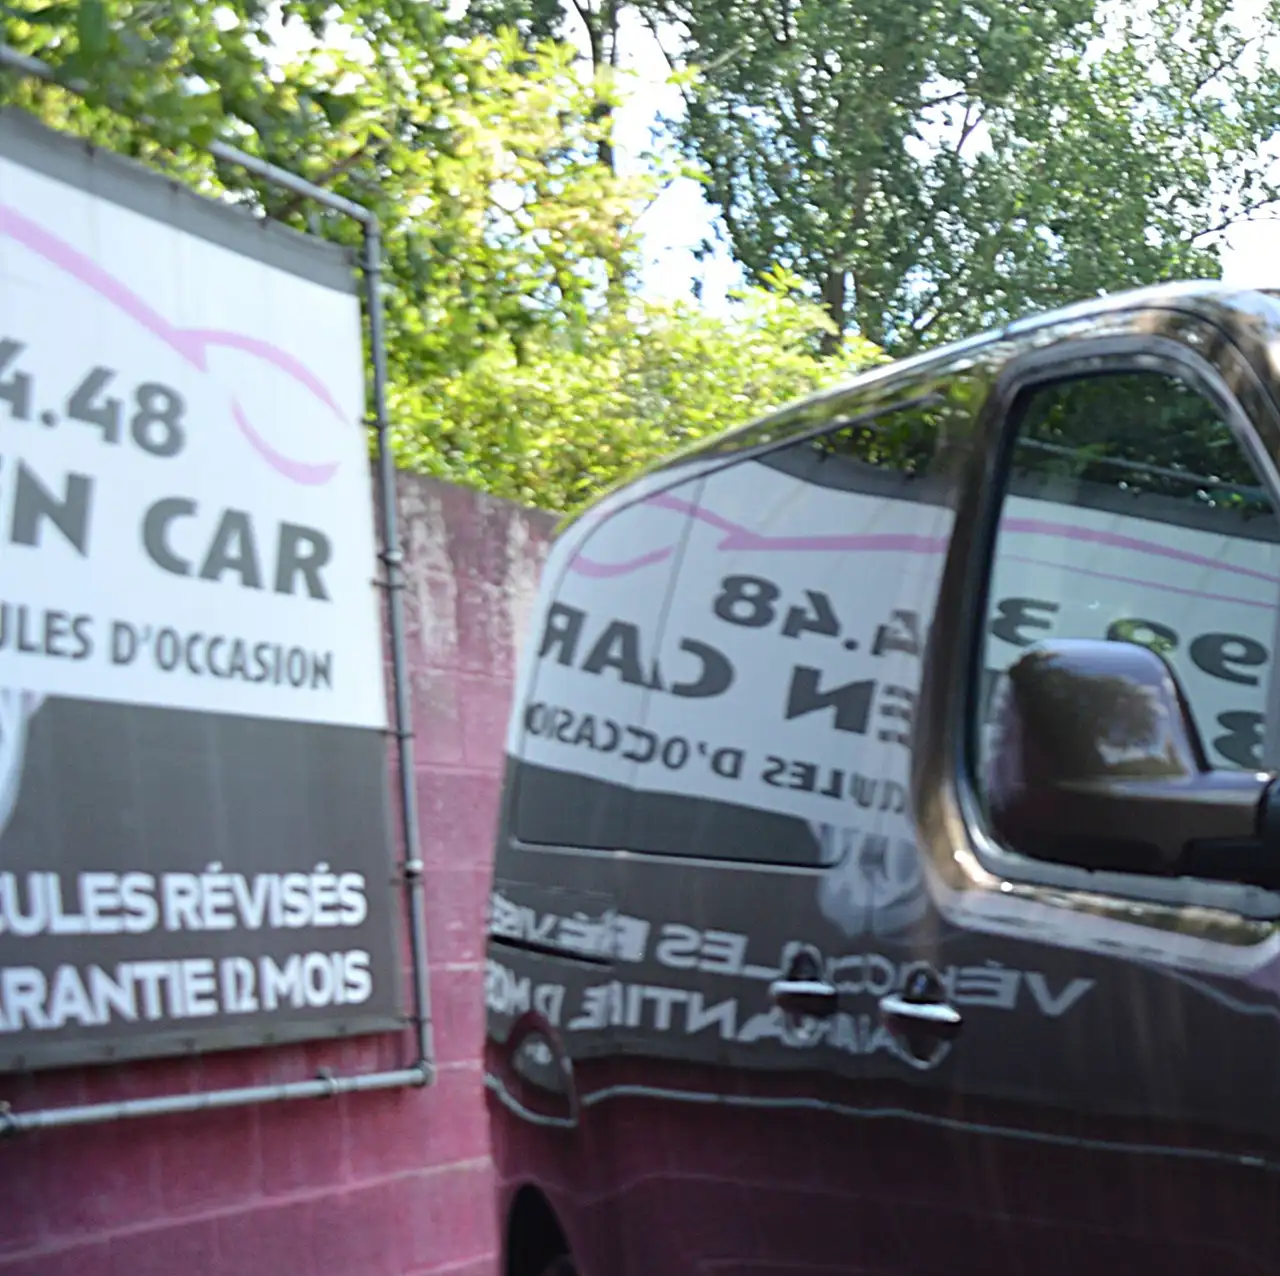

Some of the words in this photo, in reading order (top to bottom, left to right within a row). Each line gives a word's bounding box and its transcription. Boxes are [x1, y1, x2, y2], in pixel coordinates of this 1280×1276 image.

[141, 496, 334, 602] CAR
[110, 619, 334, 690] D'OCCASION
[0, 870, 159, 935] ULES
[162, 861, 369, 931] RÉVISÉS
[0, 958, 218, 1032] RANTIE
[260, 949, 372, 1011] MOIS
